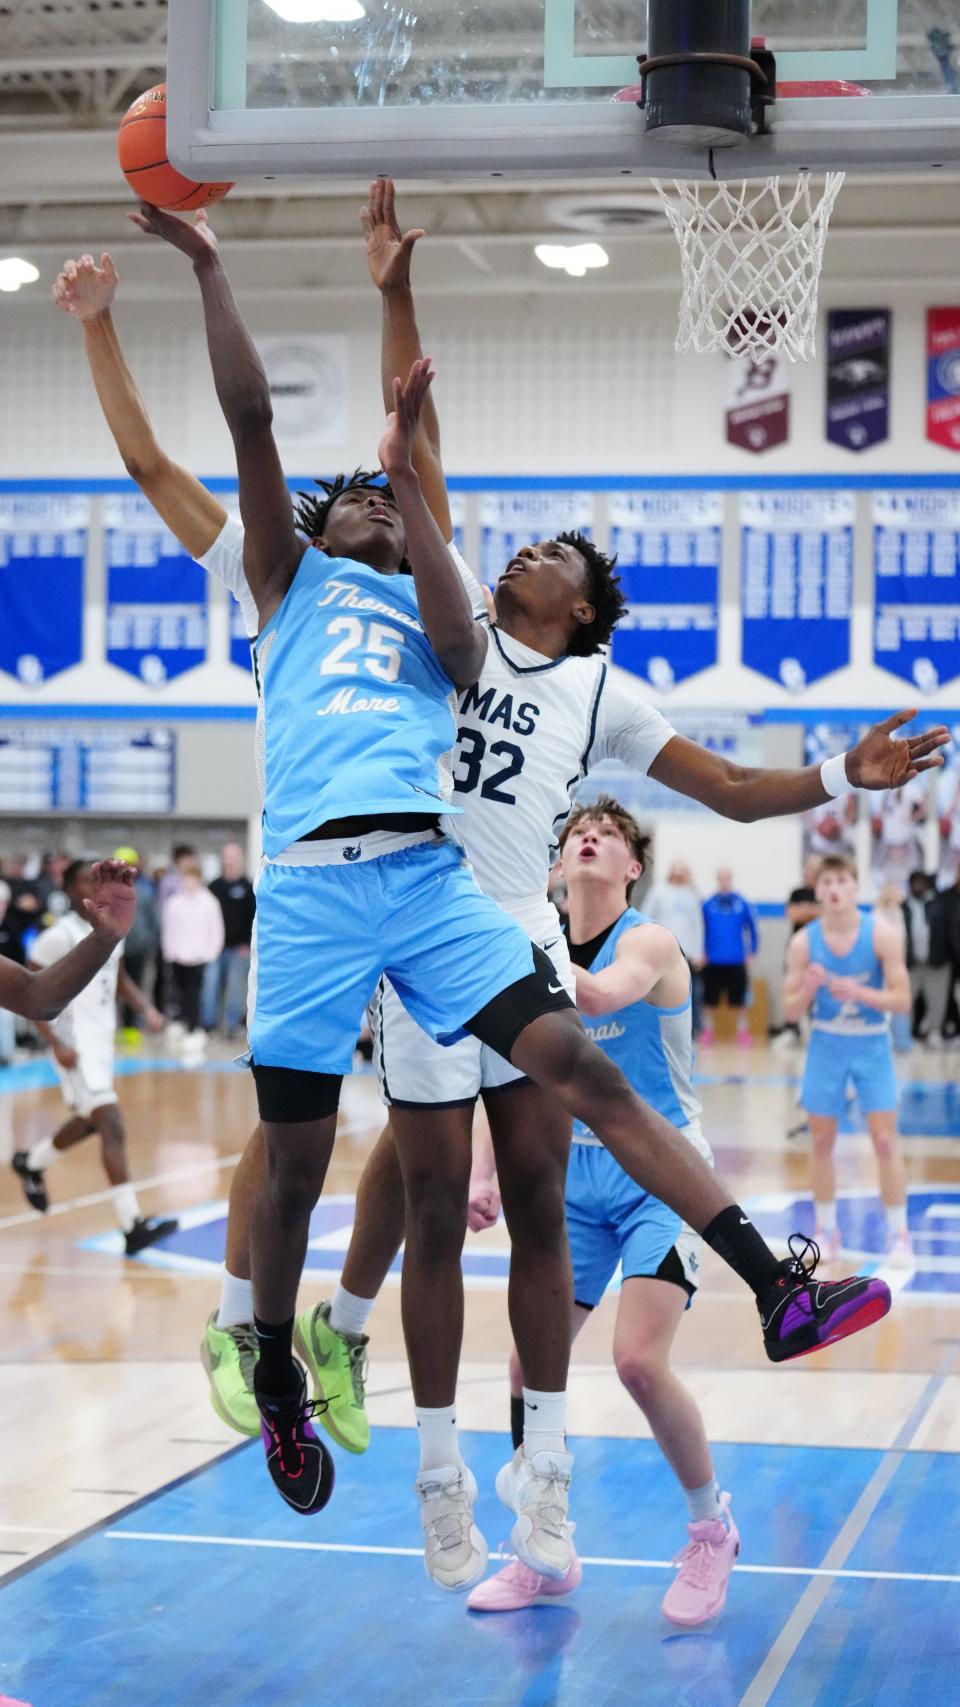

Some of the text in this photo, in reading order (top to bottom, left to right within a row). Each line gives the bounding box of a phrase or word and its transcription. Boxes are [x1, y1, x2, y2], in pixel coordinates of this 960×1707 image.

[320, 615, 405, 683] 25
[316, 686, 400, 716] More
[459, 681, 540, 736] MAS
[452, 726, 525, 806] 32
